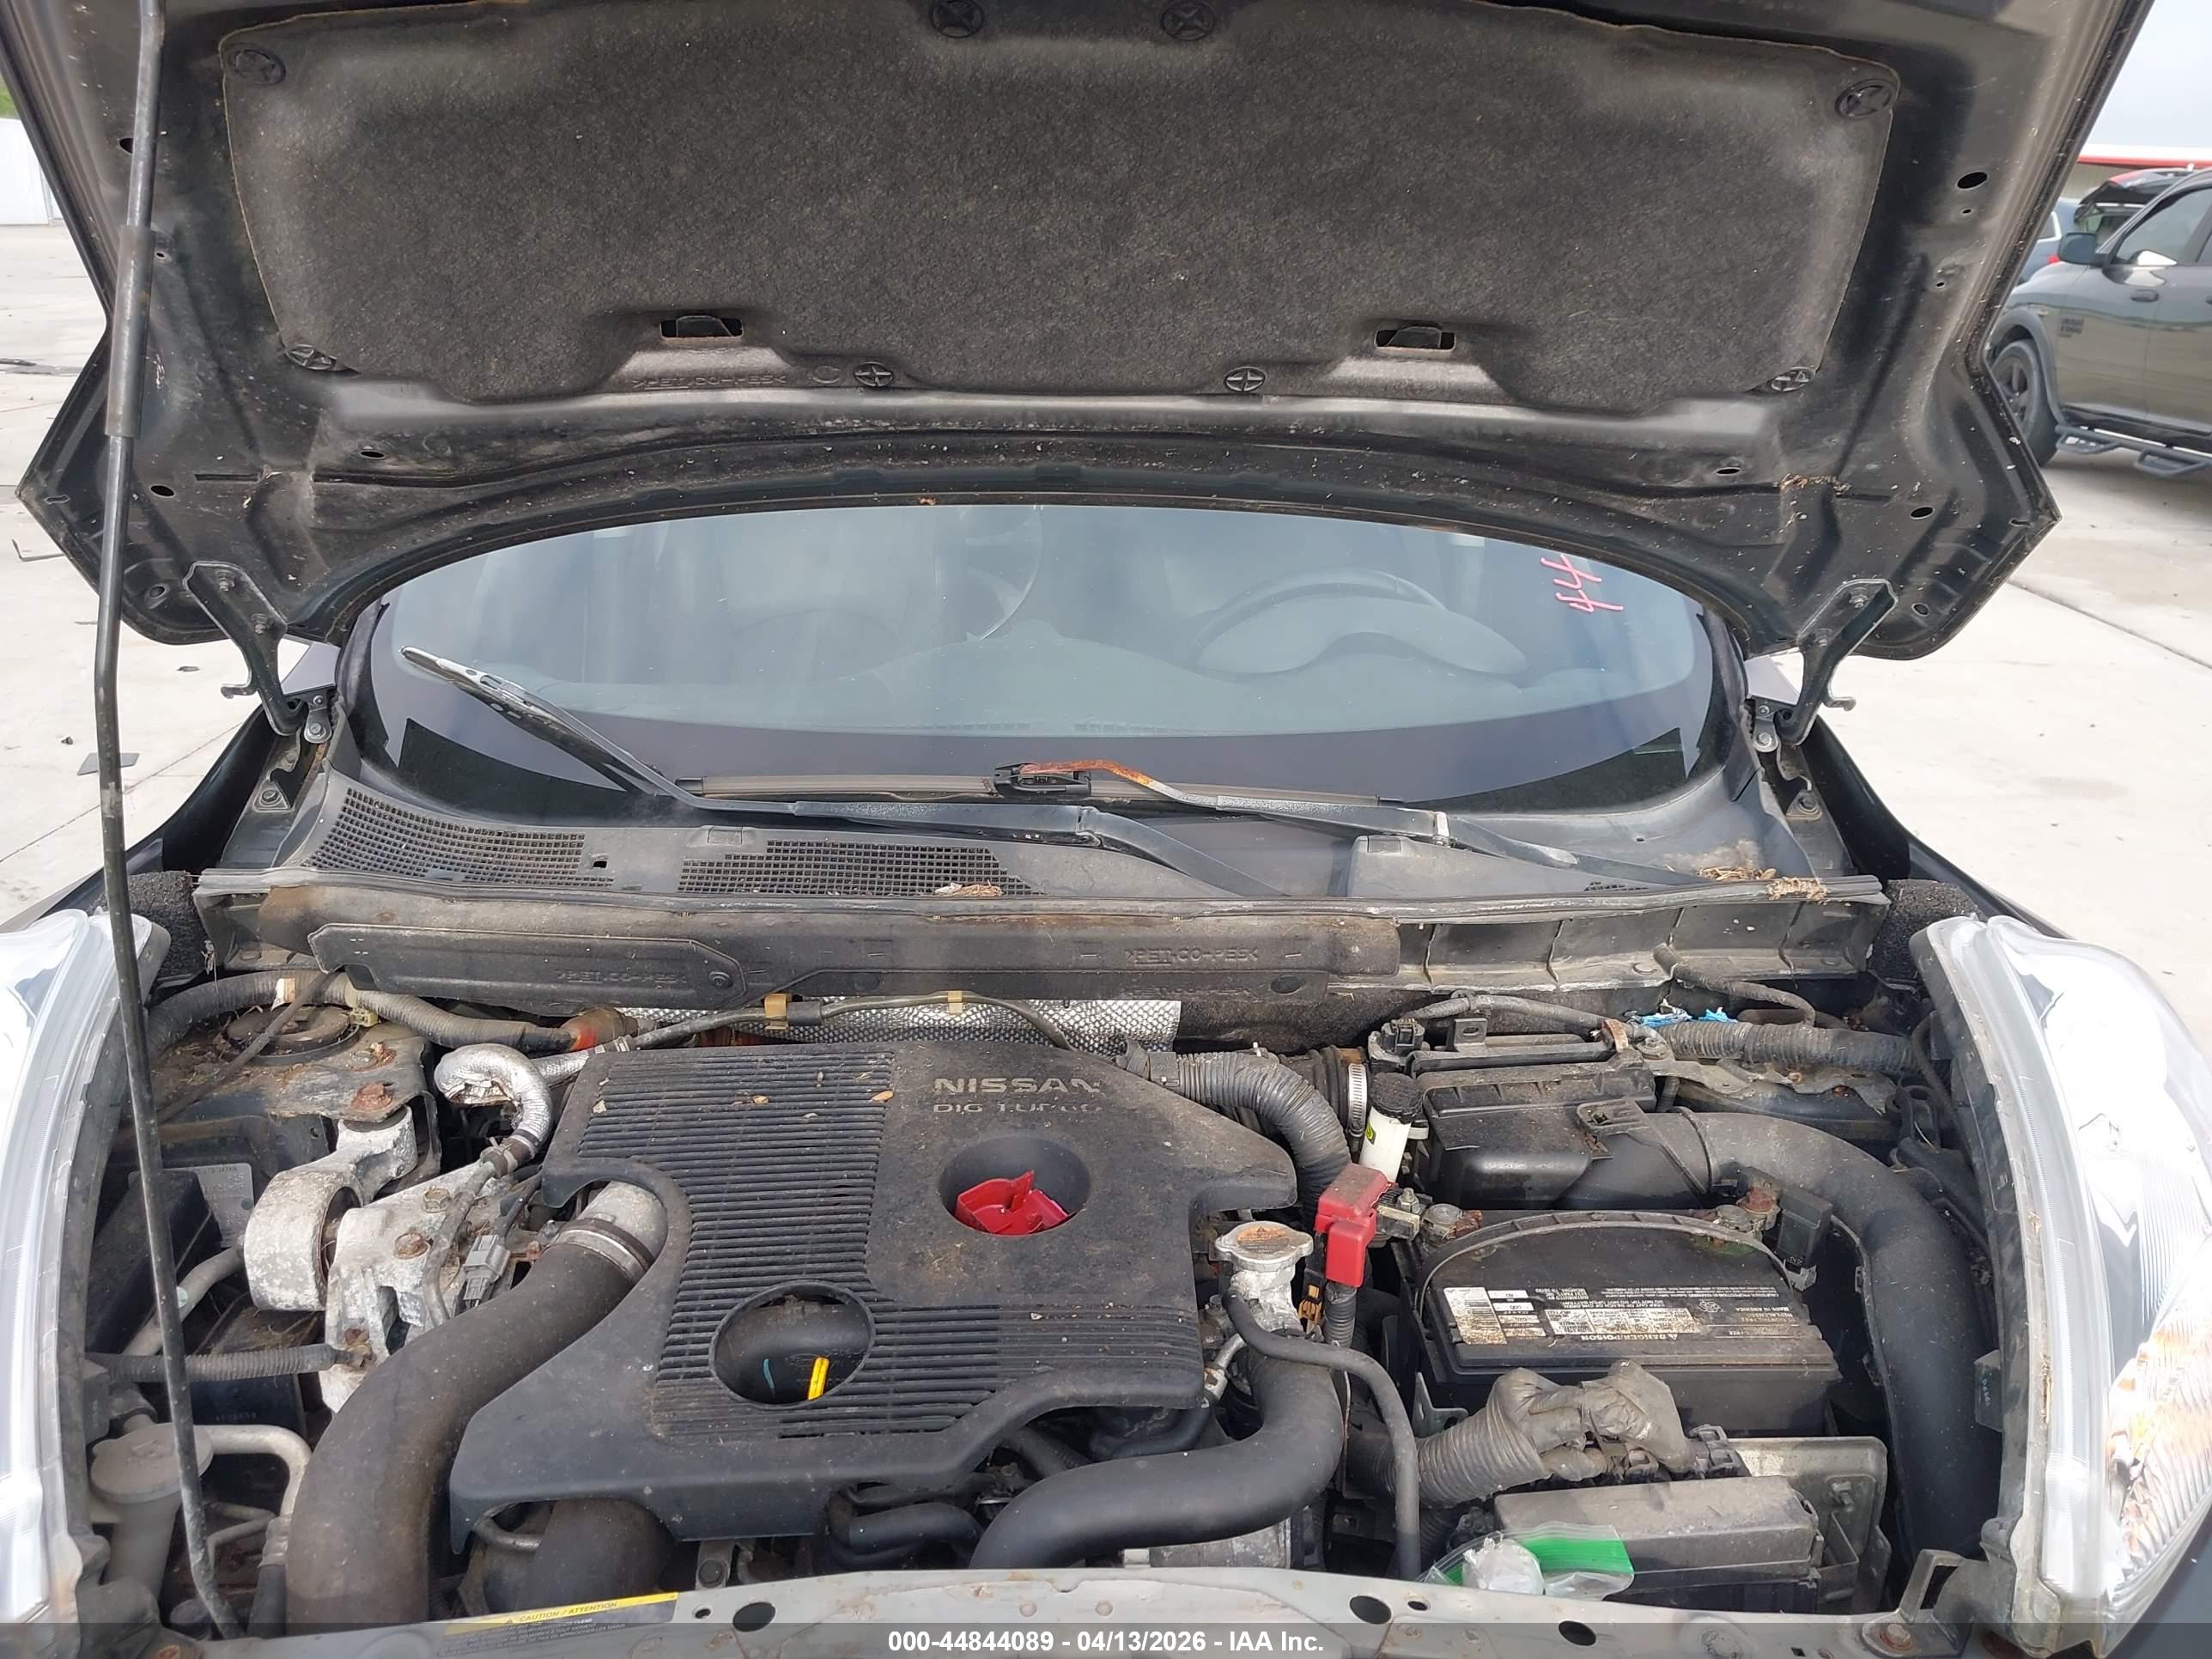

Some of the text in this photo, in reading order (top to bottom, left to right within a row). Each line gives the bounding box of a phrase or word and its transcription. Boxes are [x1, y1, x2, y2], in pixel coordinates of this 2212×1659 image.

[933, 1078, 1102, 1094] NISSAN
[933, 1103, 983, 1113] DIG
[520, 1611, 560, 1621] CAUTION
[568, 1602, 618, 1614] ATTENTION
